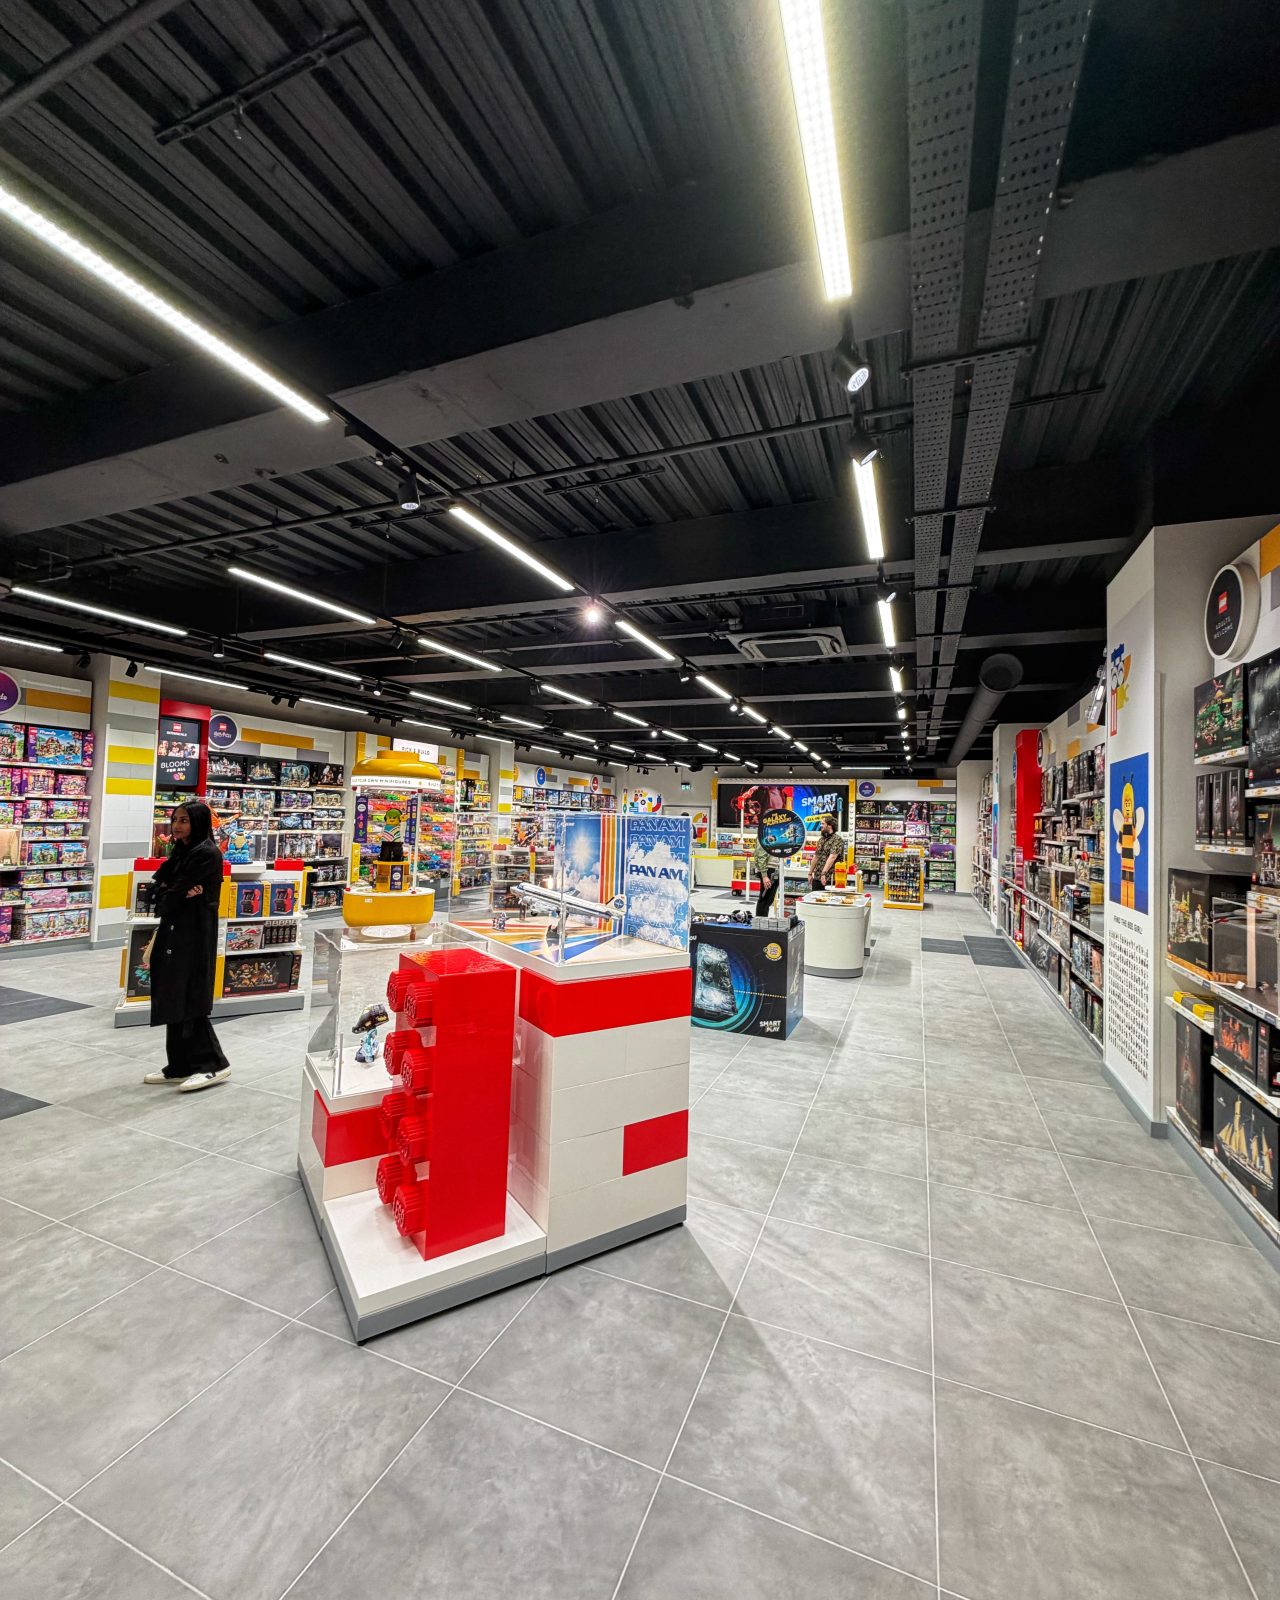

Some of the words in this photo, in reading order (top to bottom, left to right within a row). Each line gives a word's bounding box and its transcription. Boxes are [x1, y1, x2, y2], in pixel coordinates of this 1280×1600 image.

[1214, 623, 1233, 639] WELCOME
[161, 760, 190, 768] BLOOMS
[801, 793, 838, 807] SMART
[813, 804, 836, 814] PLAY
[763, 813, 788, 824] GALAXY
[630, 819, 657, 832] PAN
[658, 819, 686, 832] AM
[629, 864, 657, 878] PAN
[658, 867, 684, 881] AM
